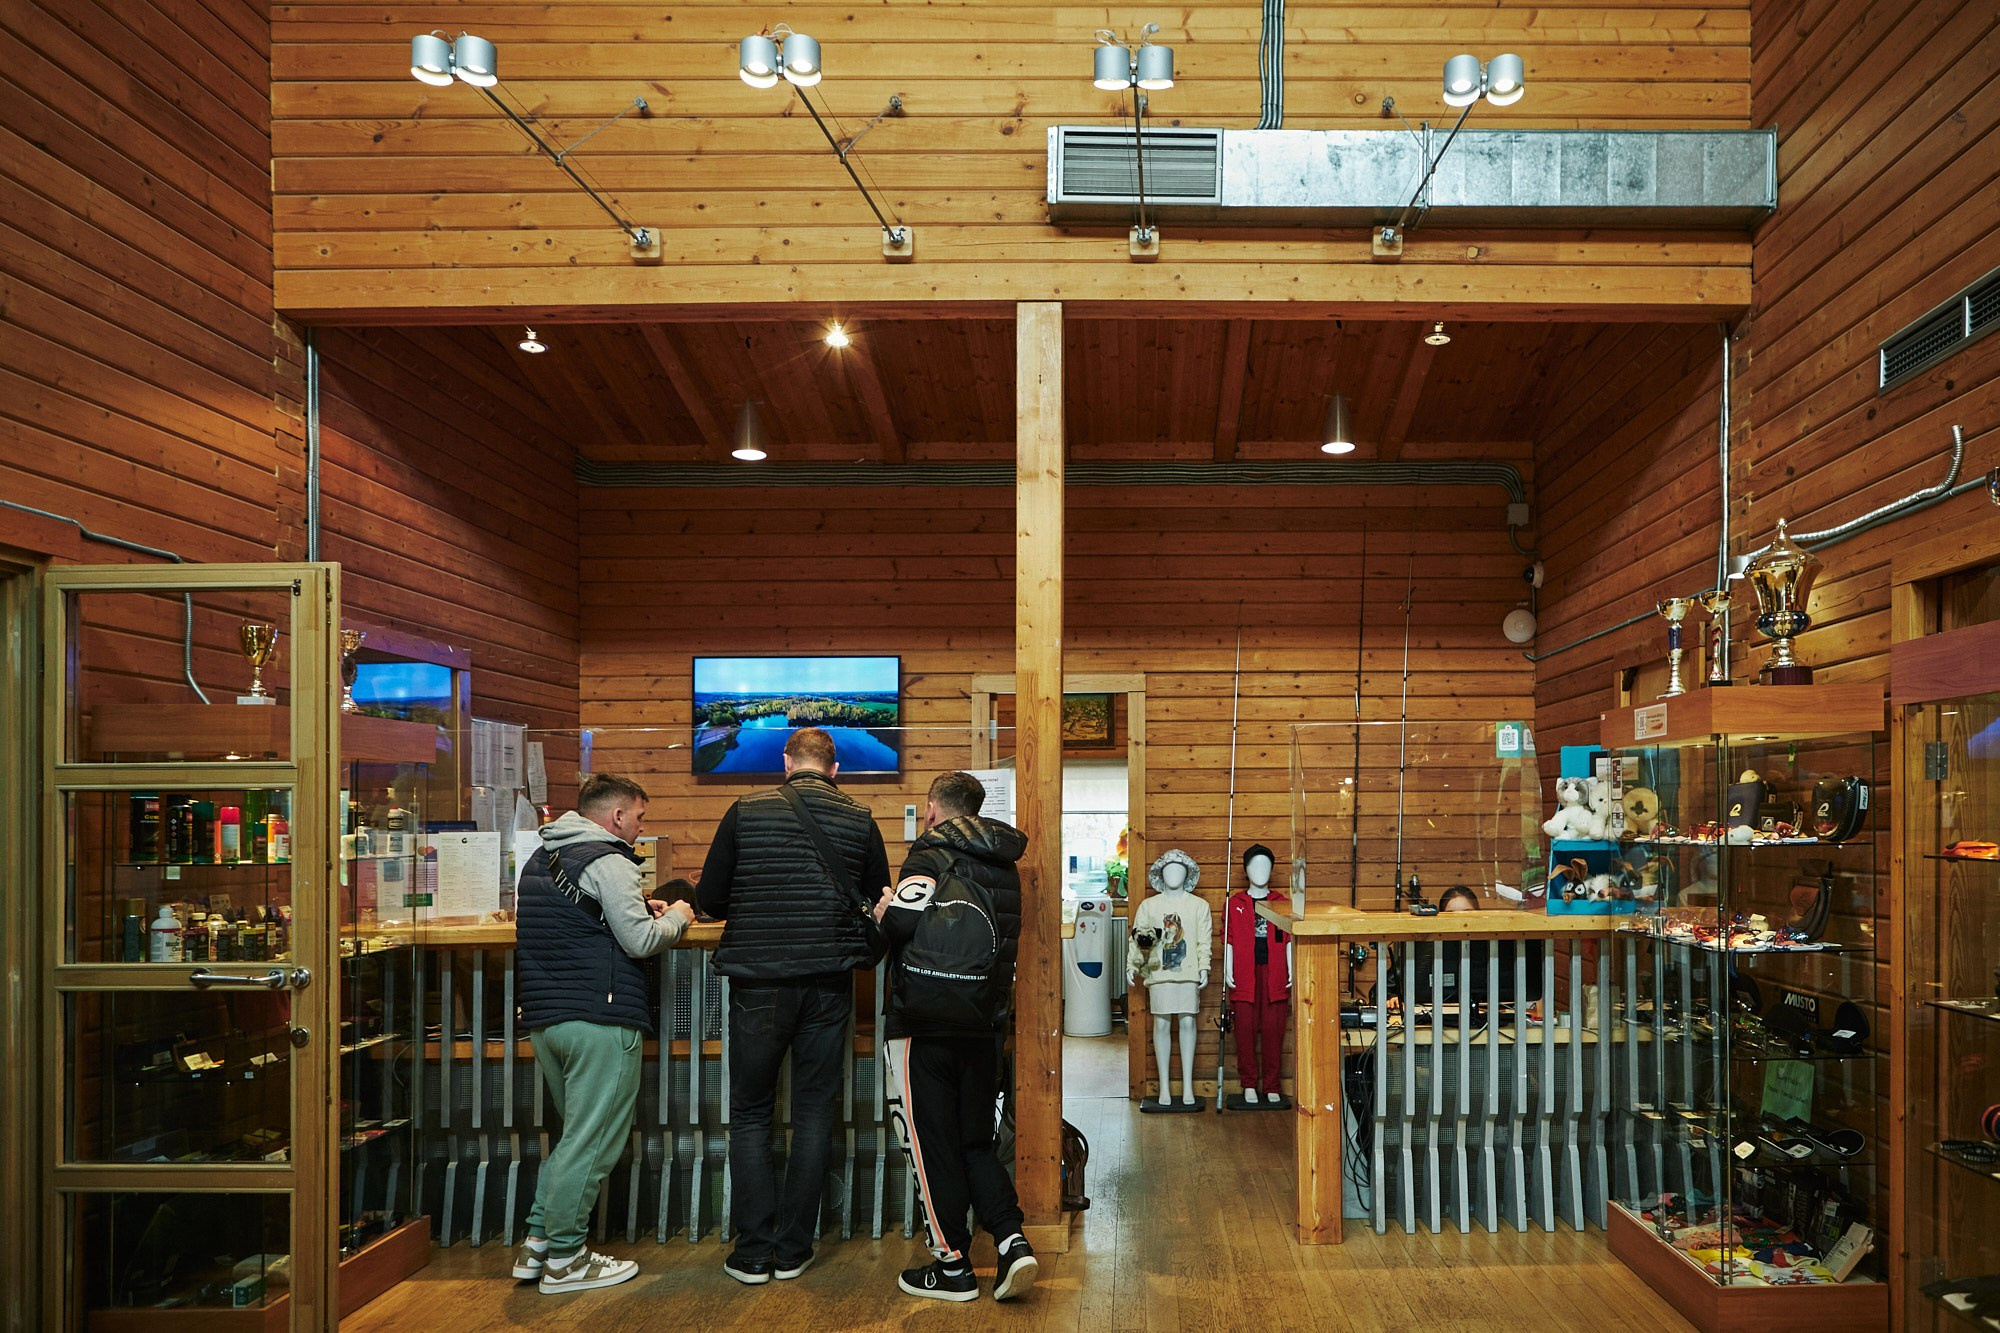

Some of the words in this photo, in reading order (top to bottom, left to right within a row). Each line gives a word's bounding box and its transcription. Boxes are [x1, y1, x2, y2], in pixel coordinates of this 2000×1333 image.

[554, 869, 586, 905] VLTN
[897, 882, 928, 903] G
[920, 968, 932, 976] LOS
[1784, 992, 1816, 1013] MUSTO
